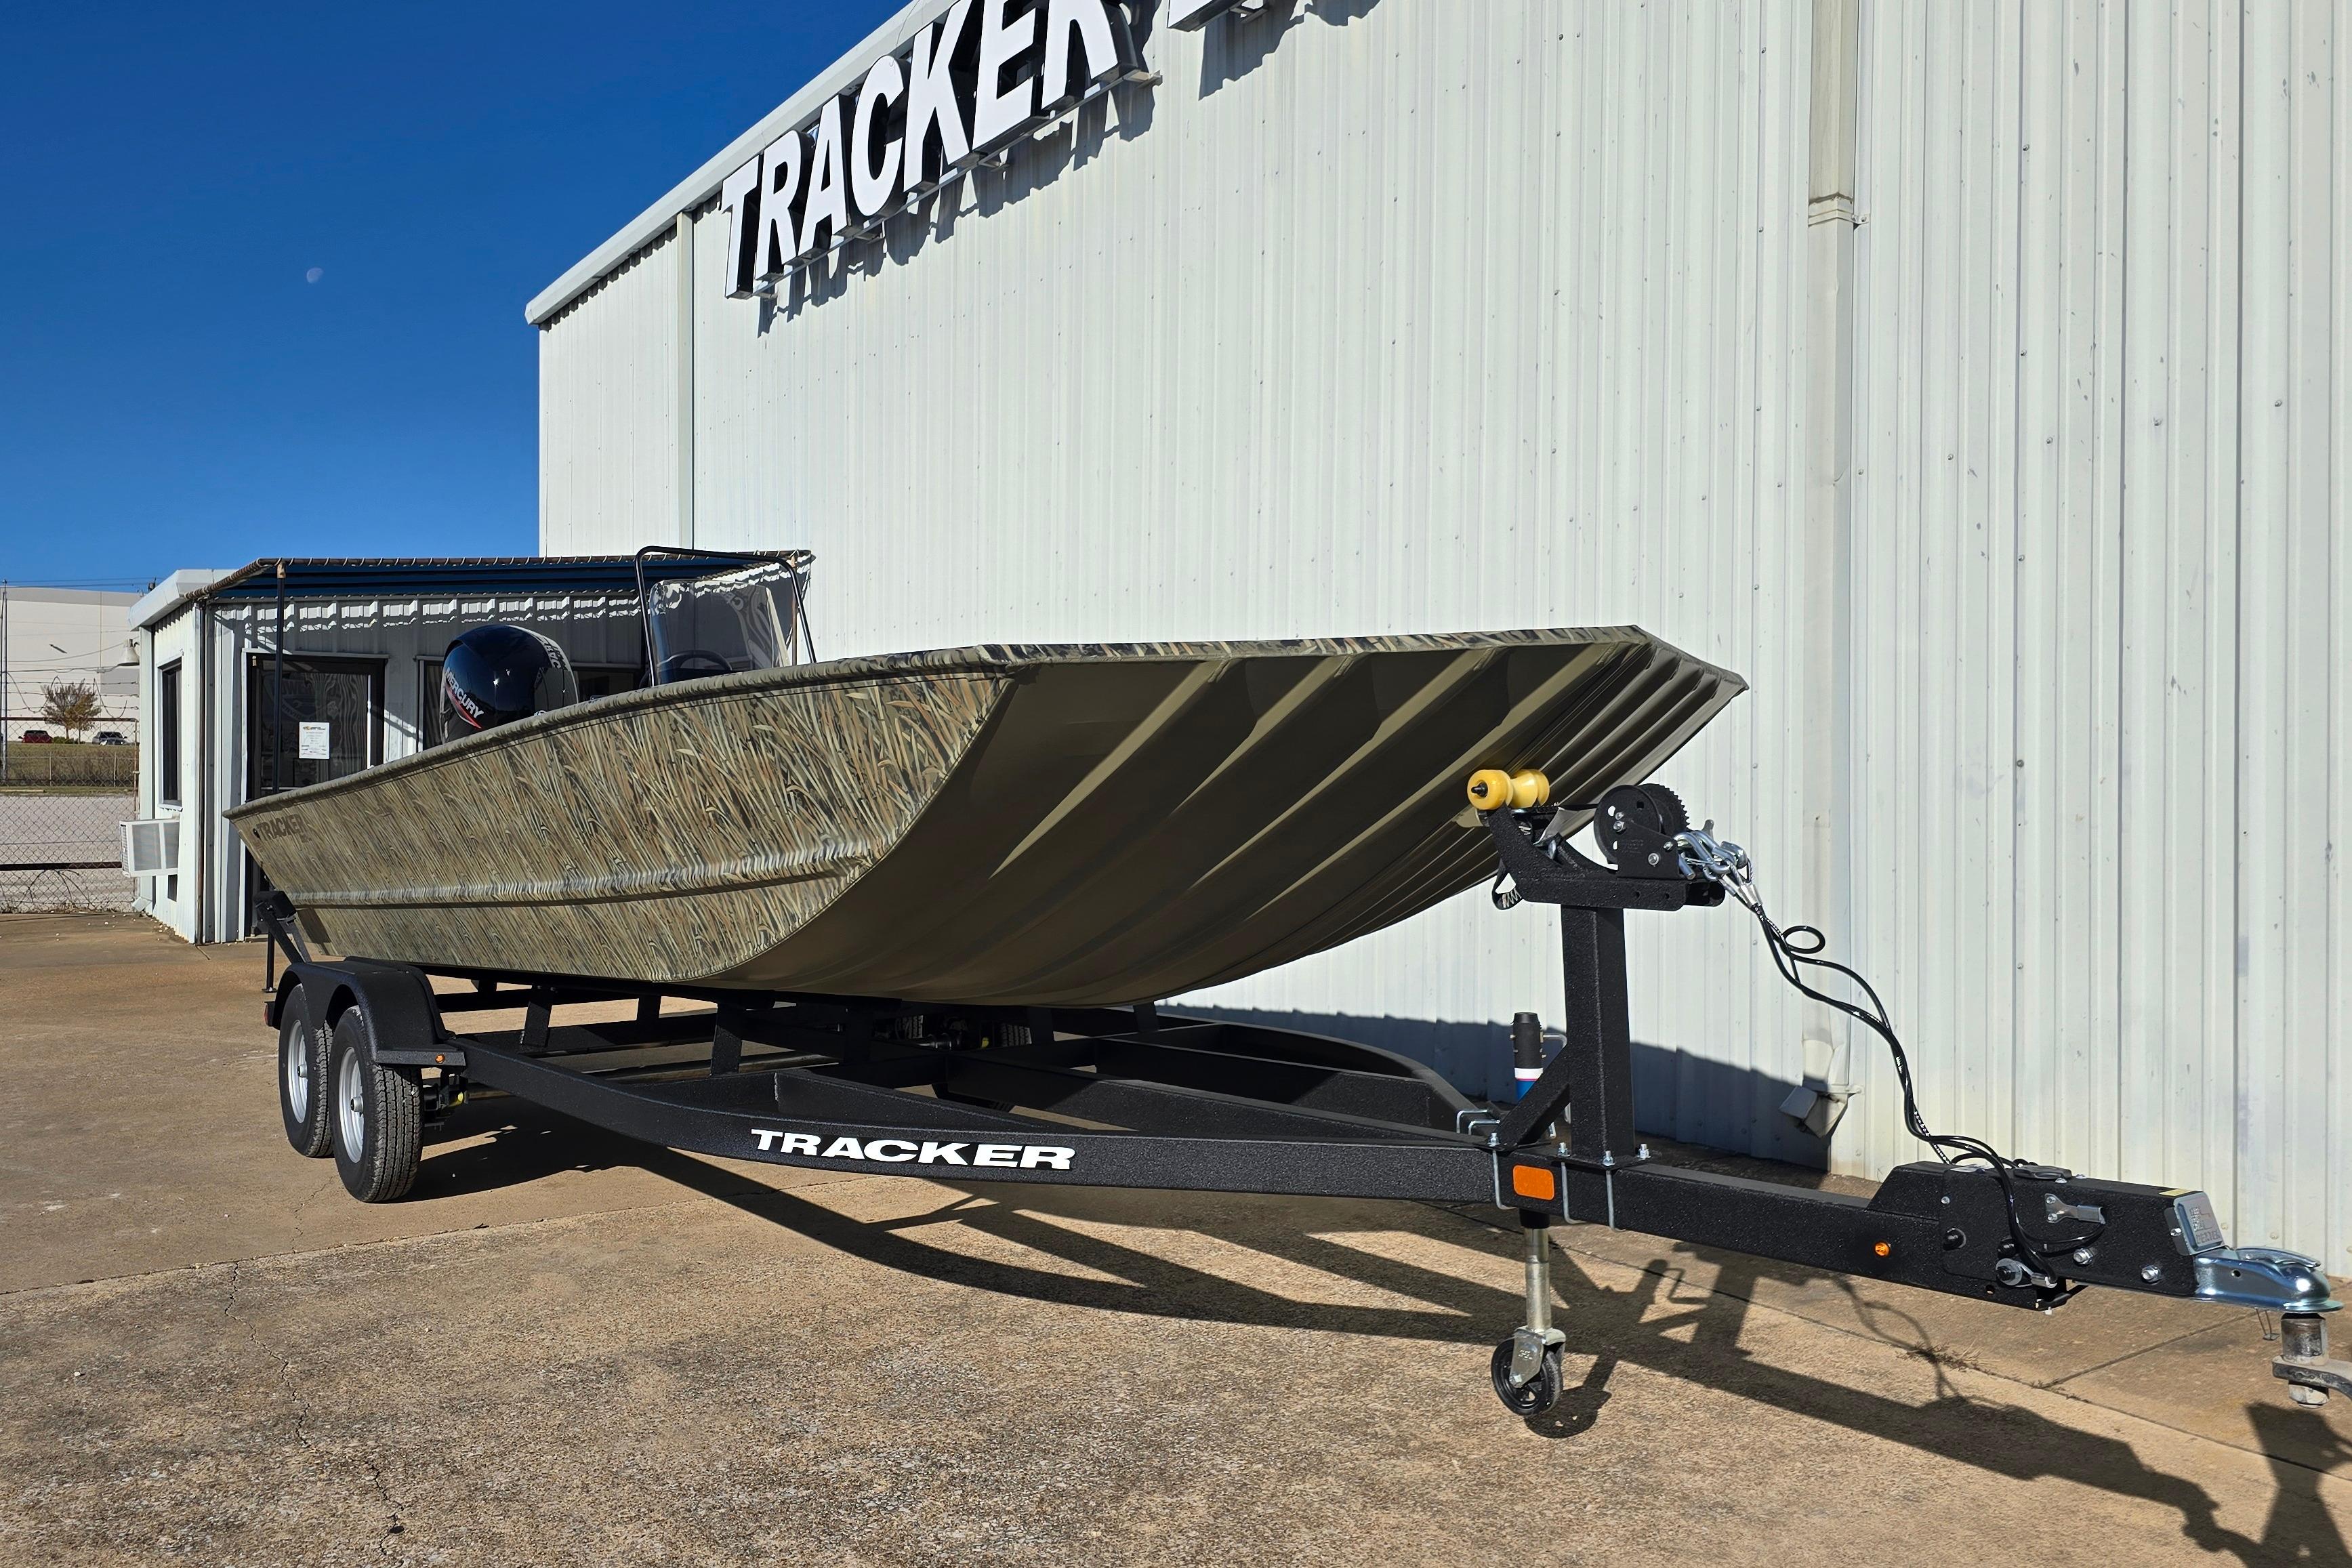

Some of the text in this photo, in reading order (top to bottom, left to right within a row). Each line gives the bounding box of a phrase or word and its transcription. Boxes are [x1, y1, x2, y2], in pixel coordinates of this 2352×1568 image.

[722, 0, 1119, 298] TRACKER
[445, 667, 484, 718] MERCURY
[256, 814, 306, 841] TRACKER
[751, 1128, 1075, 1170] TRACKER
